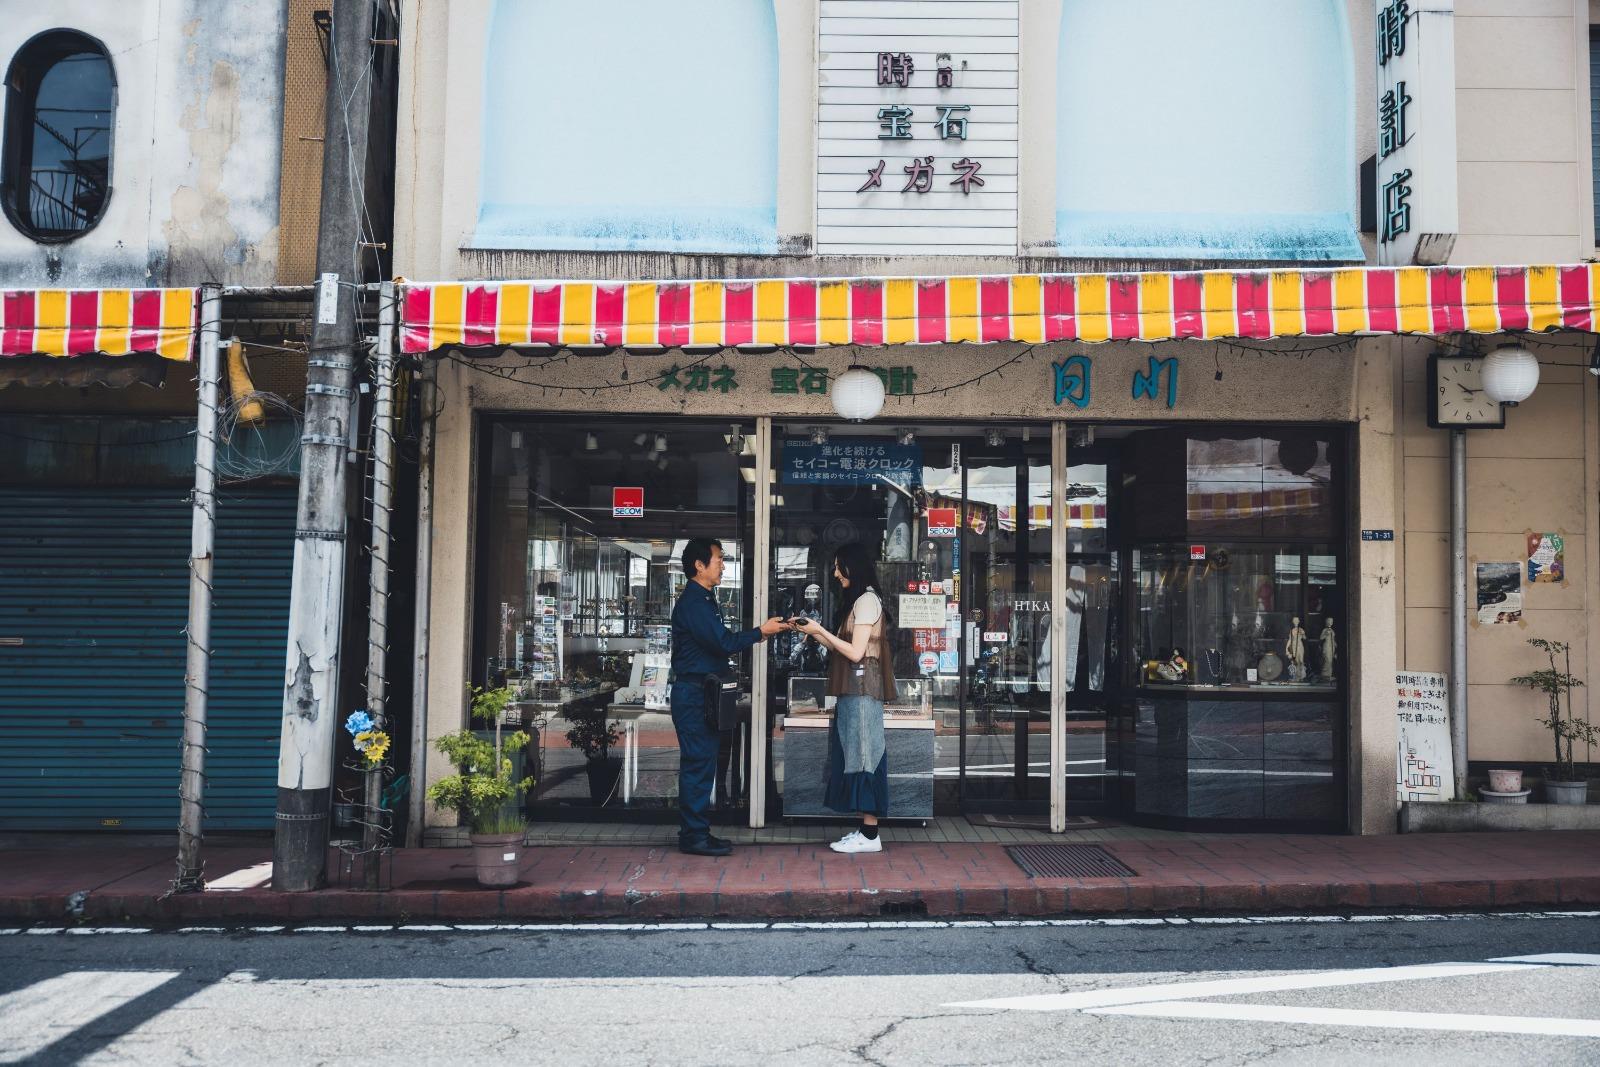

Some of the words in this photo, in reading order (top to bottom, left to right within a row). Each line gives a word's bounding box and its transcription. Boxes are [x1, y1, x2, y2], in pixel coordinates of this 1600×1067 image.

[877, 105, 971, 140] 宝石
[856, 156, 985, 195] メガネ
[1464, 362, 1472, 372] 12
[656, 364, 740, 394] メガネ
[770, 366, 829, 395] 宝石
[1439, 386, 1446, 396] 9
[1465, 411, 1472, 421] 6
[821, 445, 886, 456] 進化を続ける
[792, 457, 914, 470] セイコー電波クロック
[615, 507, 642, 515] SECOM
[929, 527, 955, 535] SECOM
